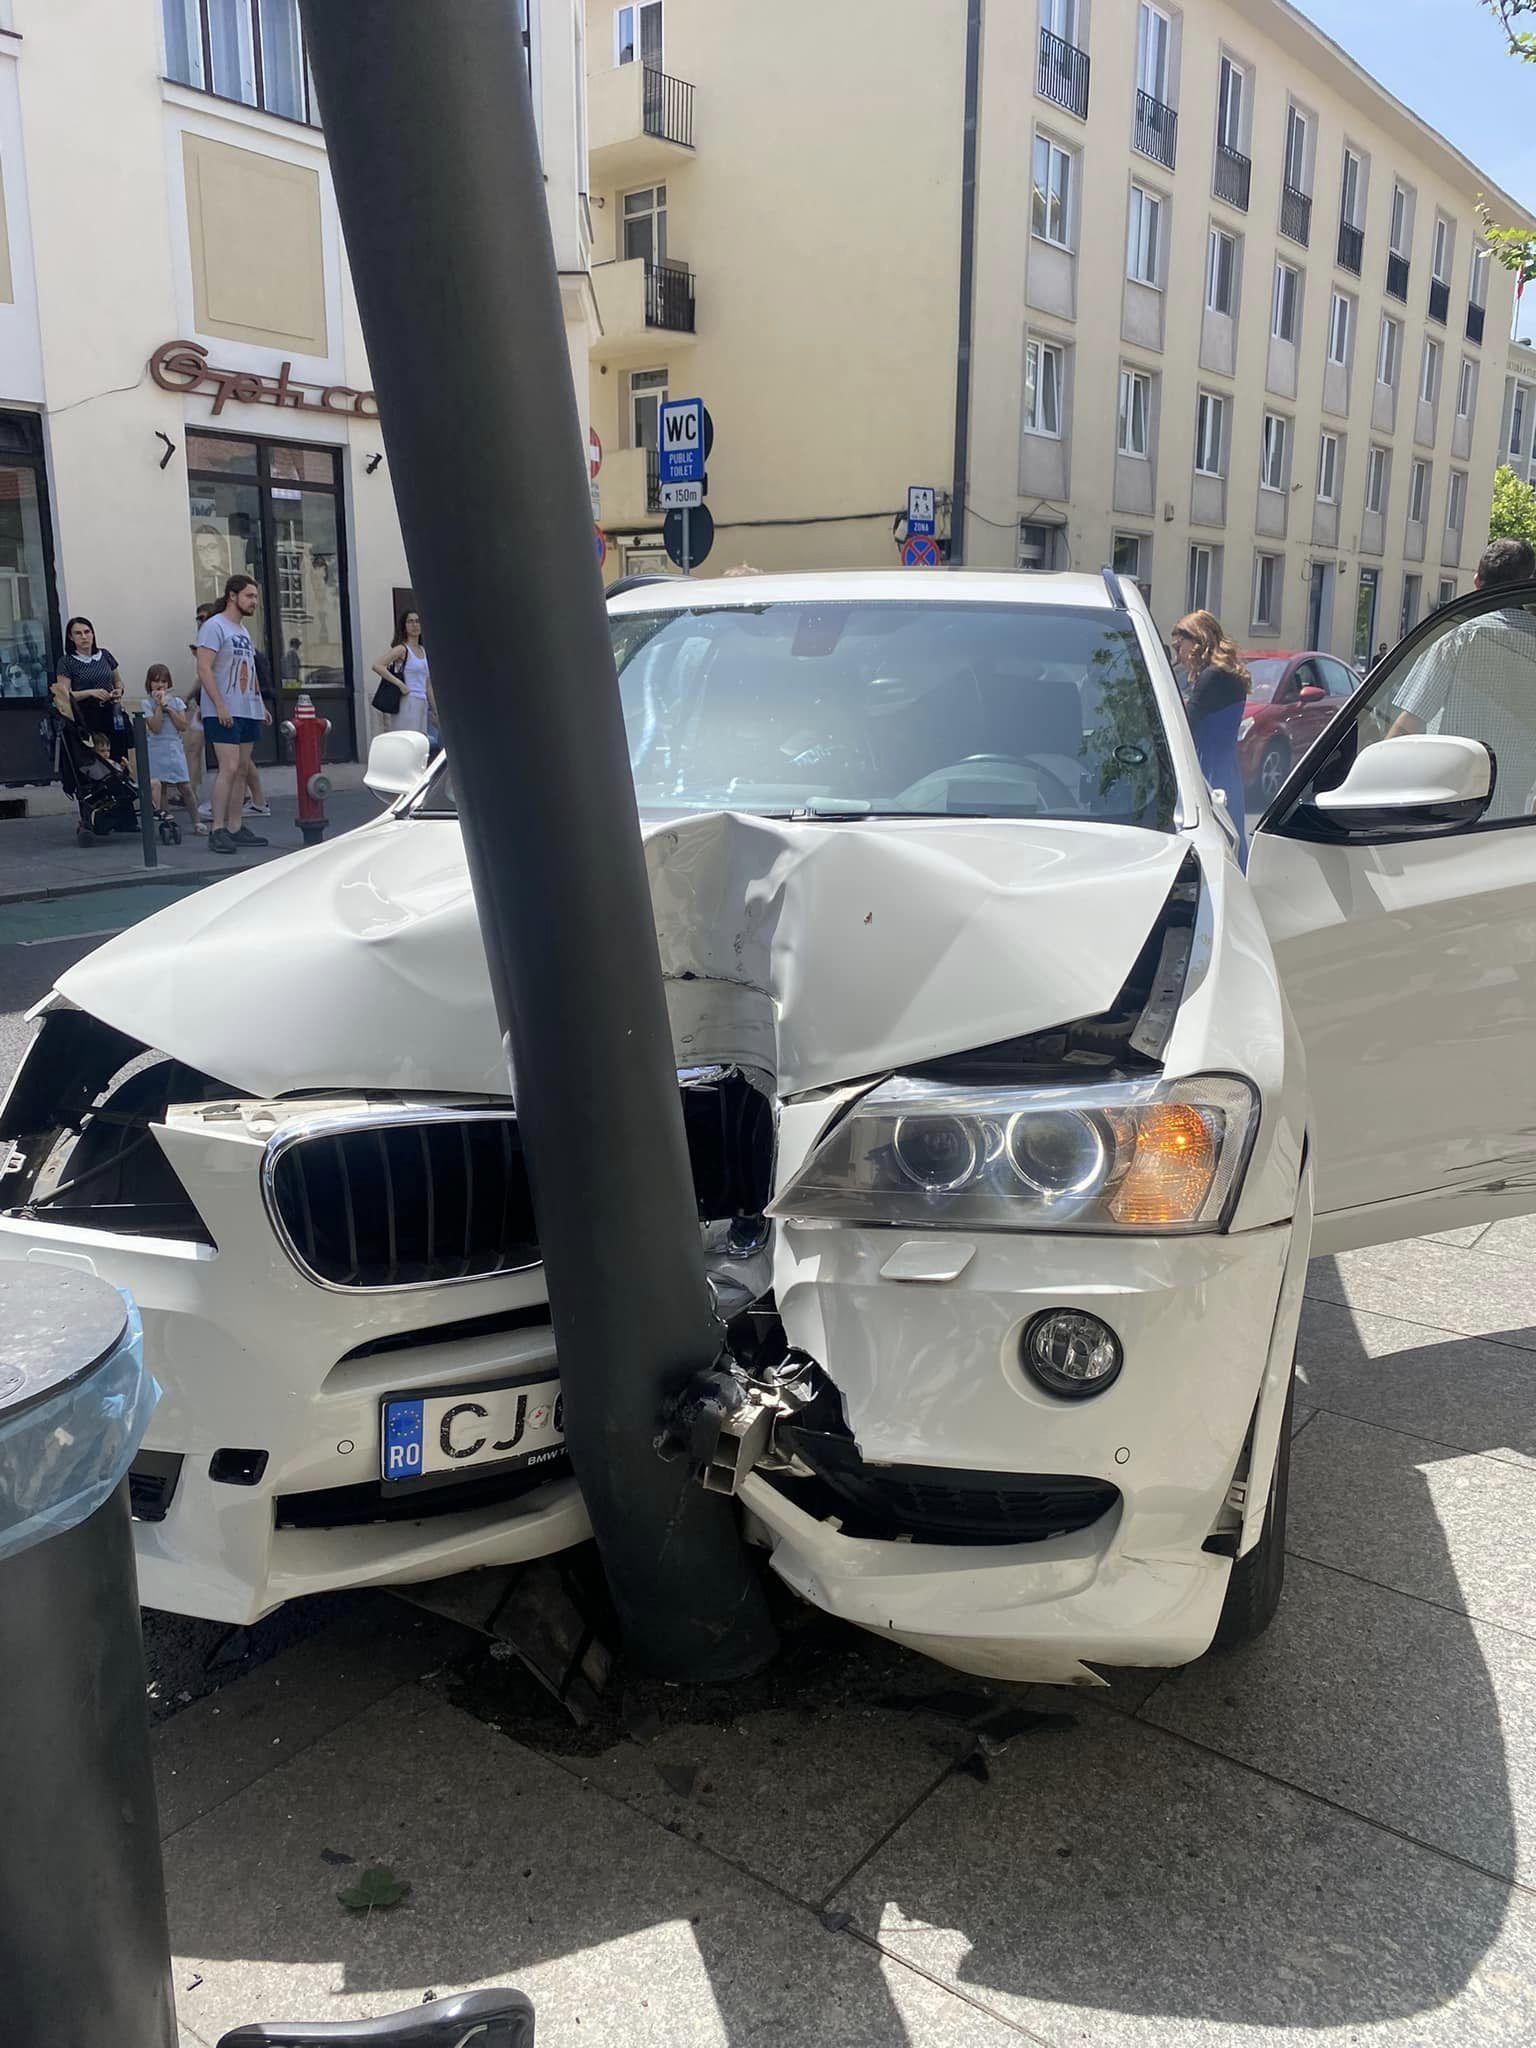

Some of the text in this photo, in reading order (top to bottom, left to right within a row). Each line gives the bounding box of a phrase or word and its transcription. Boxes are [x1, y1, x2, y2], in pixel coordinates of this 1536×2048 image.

[666, 414, 697, 442] WC
[669, 452, 694, 464] PUBLIC
[670, 465, 693, 477] TOILET
[675, 489, 697, 502] 150m
[390, 1443, 420, 1469] RO
[528, 1449, 558, 1465] BMW
